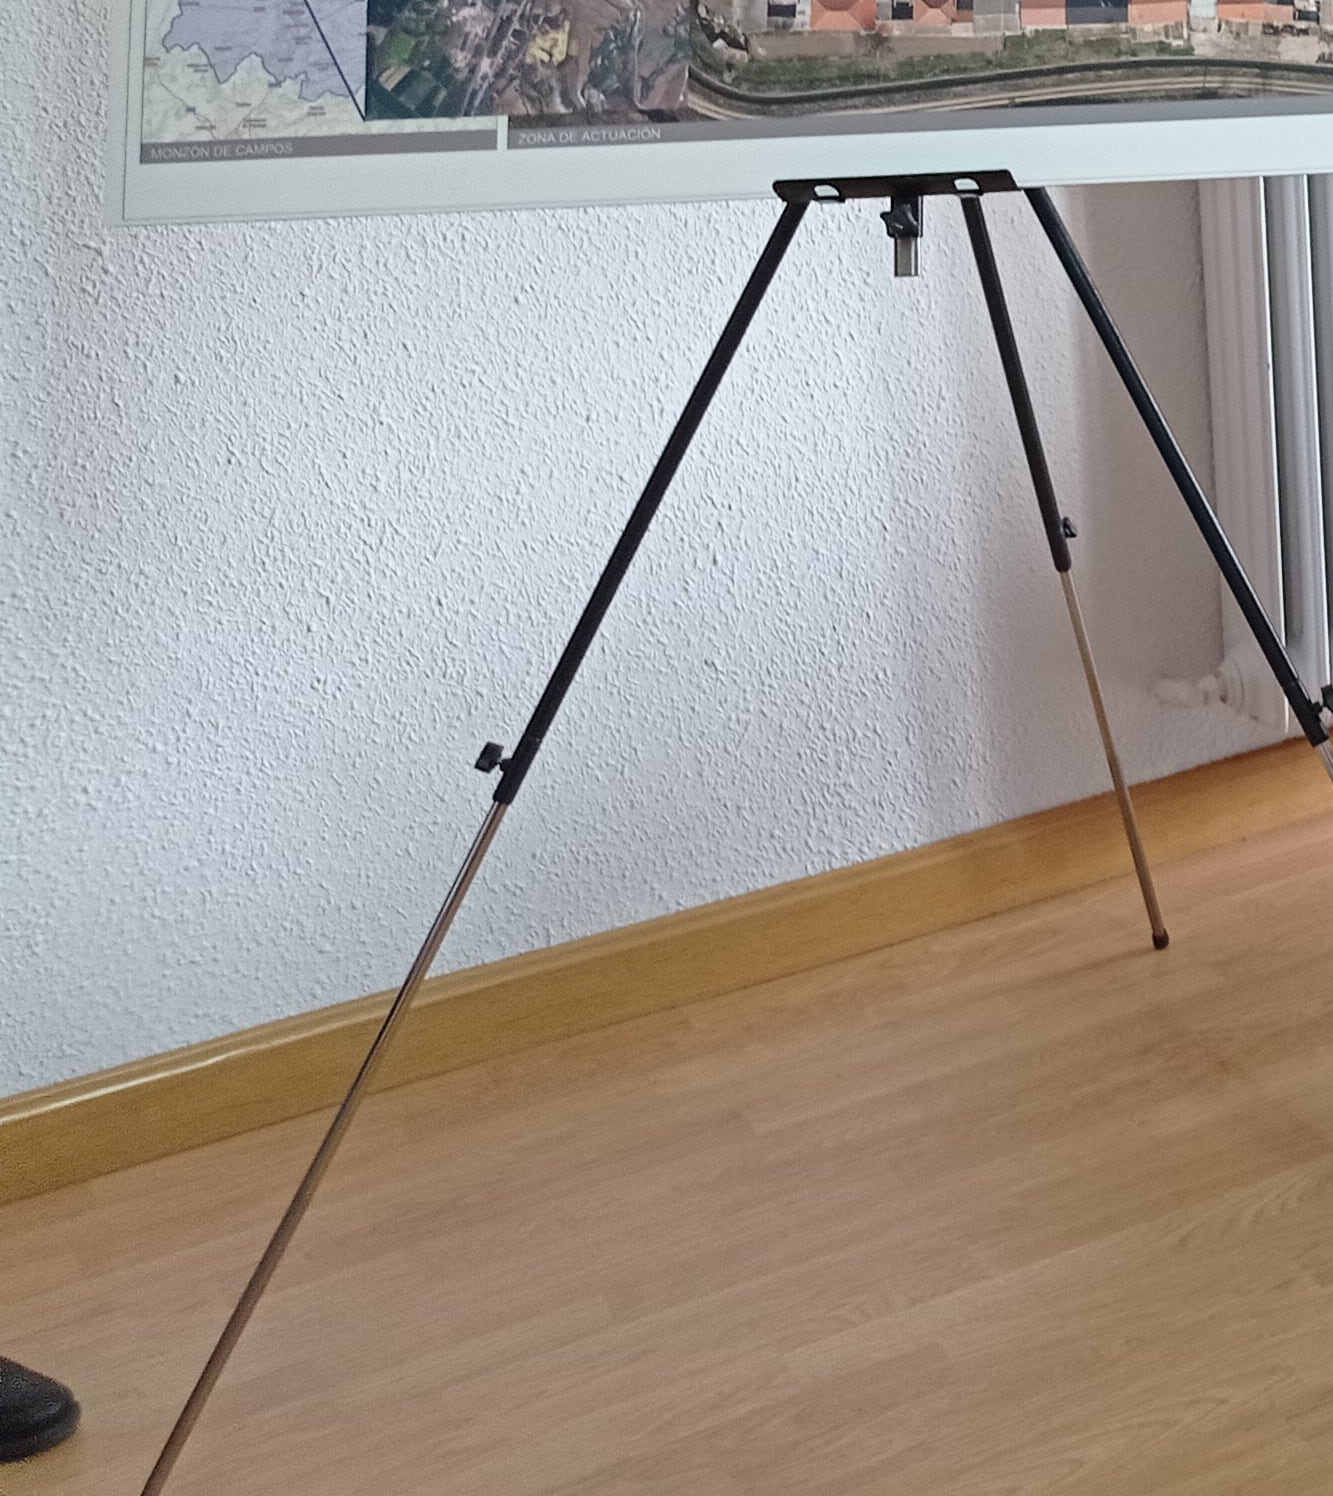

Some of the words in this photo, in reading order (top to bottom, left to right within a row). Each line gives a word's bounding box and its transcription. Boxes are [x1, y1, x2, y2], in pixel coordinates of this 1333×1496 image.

[518, 132, 556, 145] ZONA
[558, 131, 576, 143] DE
[581, 126, 662, 143] ACTUACIÓN
[213, 145, 232, 158] DE
[235, 142, 294, 156] CAMPOS
